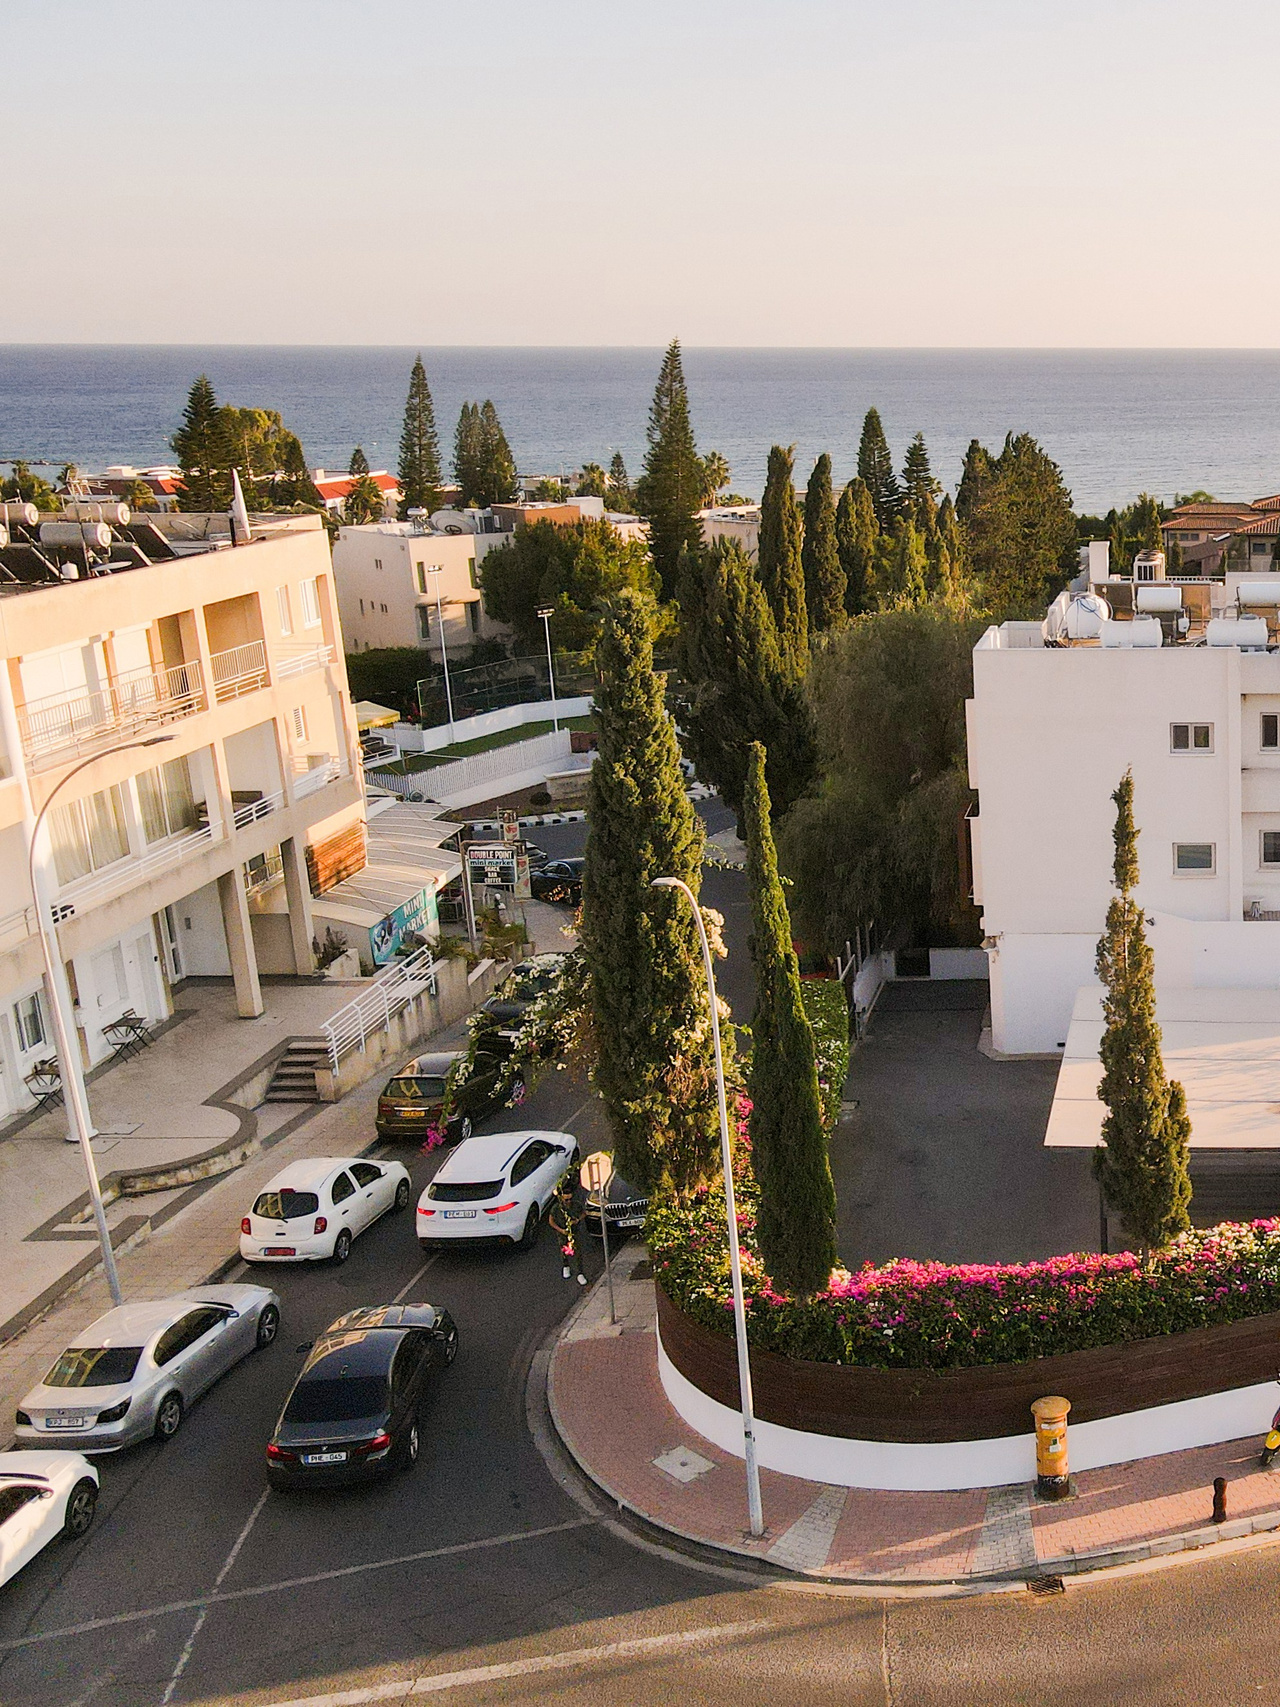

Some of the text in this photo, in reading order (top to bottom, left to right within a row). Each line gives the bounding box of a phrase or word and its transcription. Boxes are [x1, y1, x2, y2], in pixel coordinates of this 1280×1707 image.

[470, 850, 513, 859] DOUBLE POINT
[470, 859, 514, 867] mini market
[403, 893, 423, 919] MINI
[398, 907, 431, 942] MARKET
